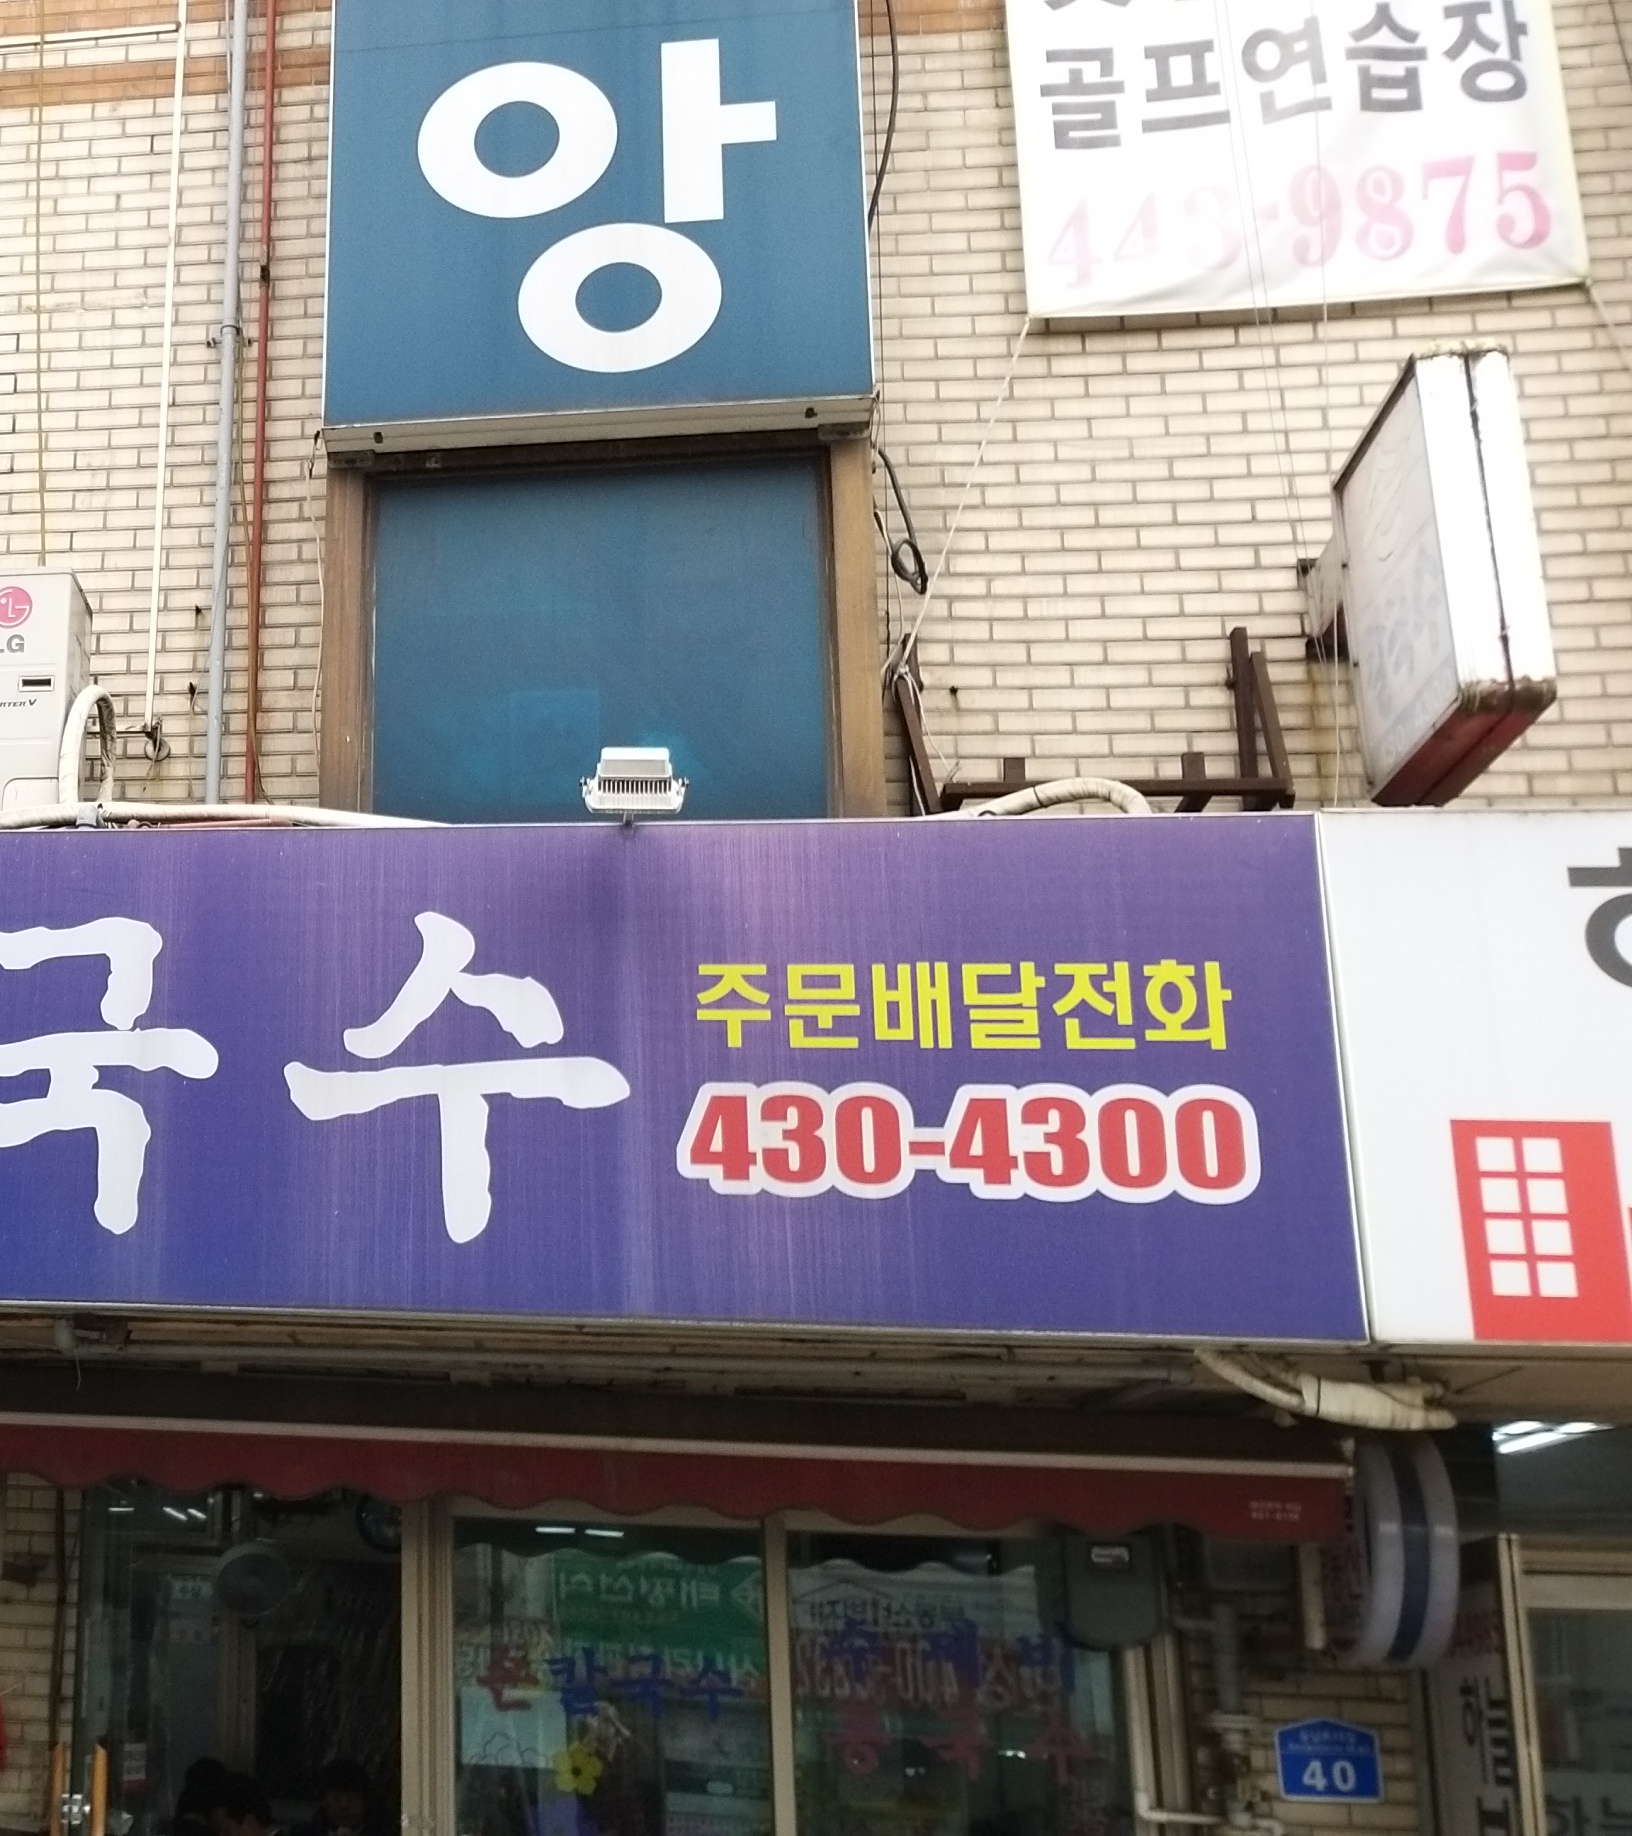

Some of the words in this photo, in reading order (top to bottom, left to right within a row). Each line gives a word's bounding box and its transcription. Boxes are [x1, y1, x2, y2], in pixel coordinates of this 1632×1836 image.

[1039, 0, 1528, 150] 골프연습장
[417, 38, 778, 373] 앙
[1047, 150, 1551, 290] 443-9875
[695, 960, 1233, 1051] 주문배달전화
[676, 1080, 1262, 1205] 430-4300
[1302, 1758, 1357, 1793] 40
